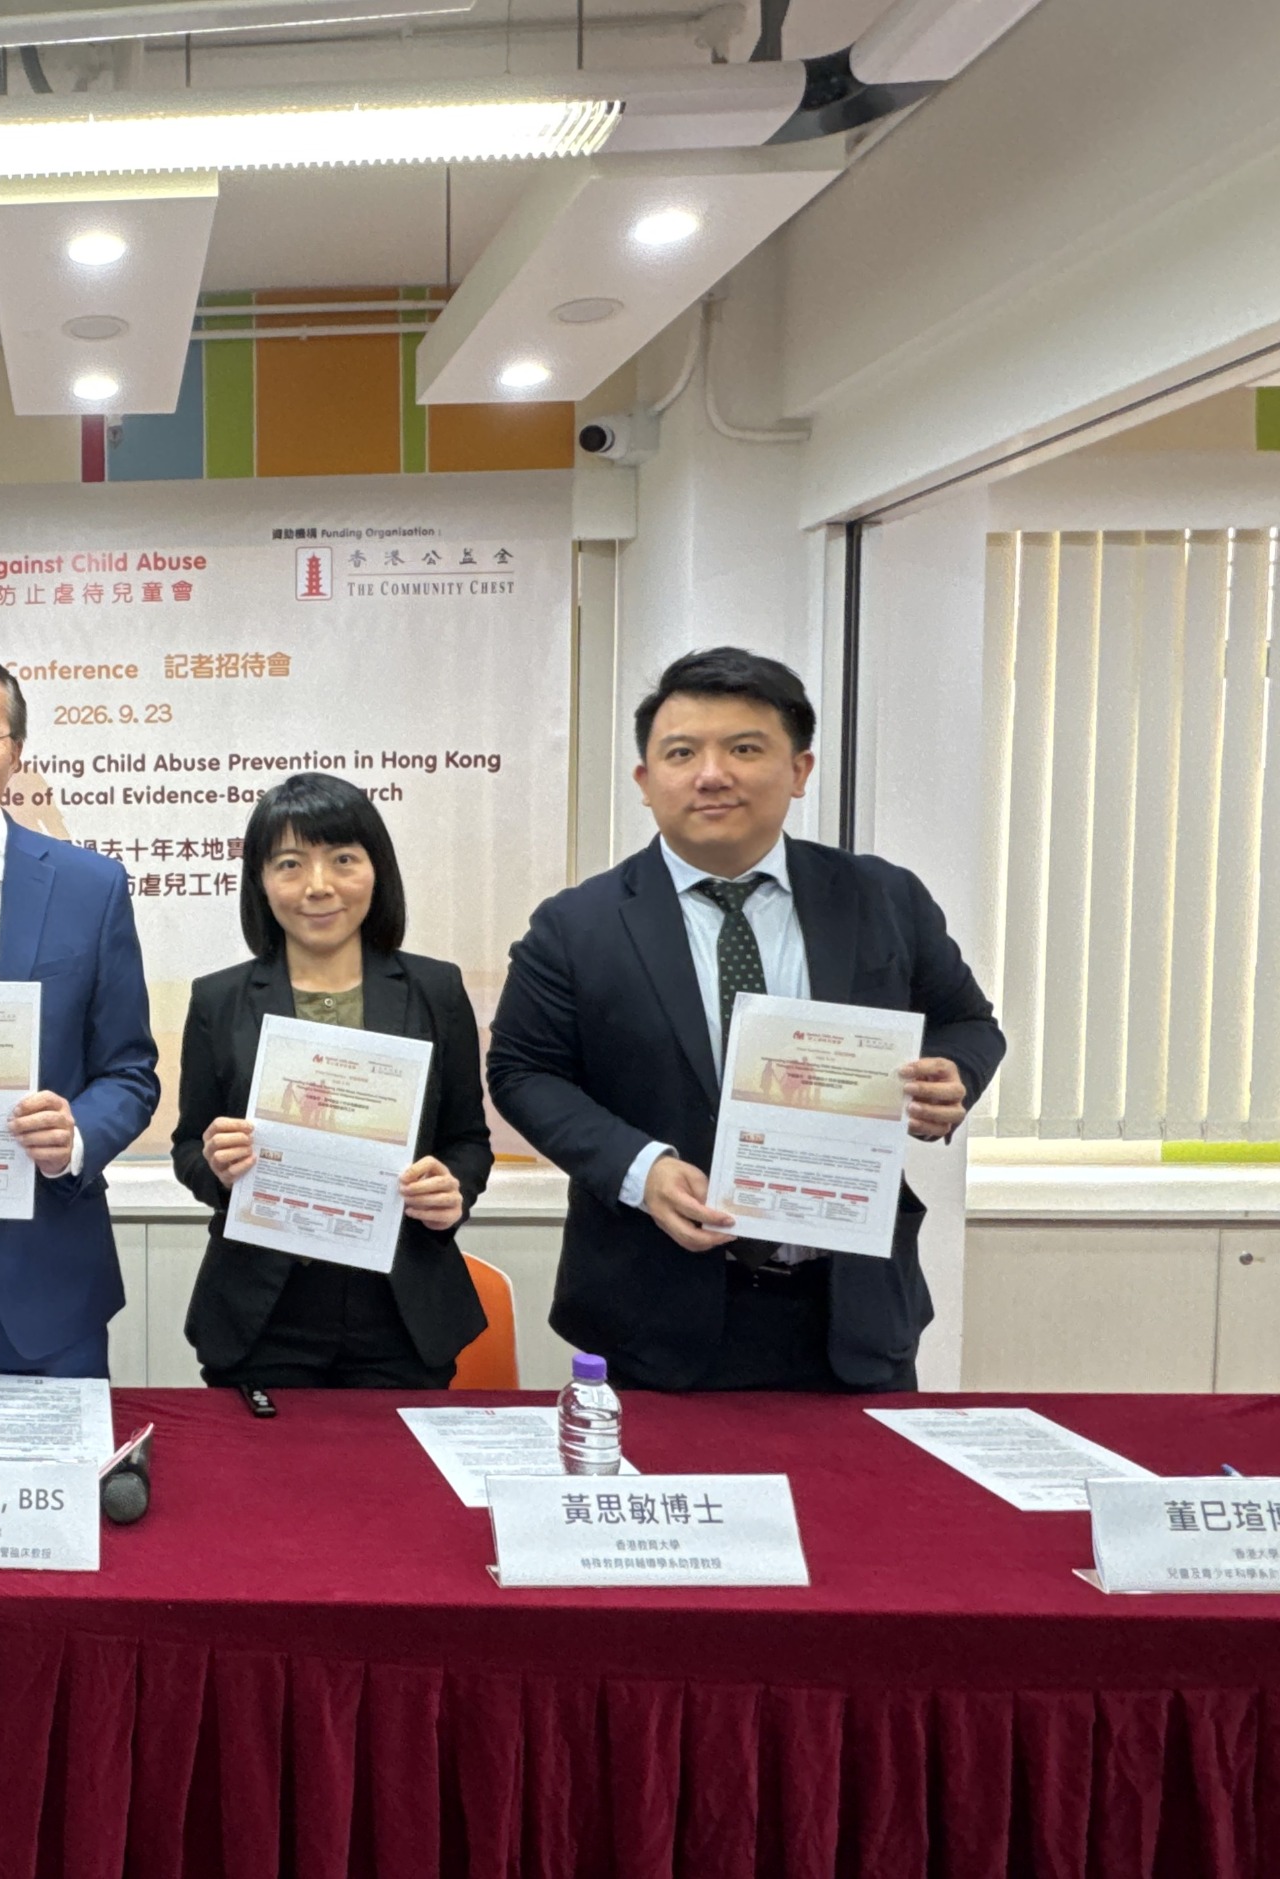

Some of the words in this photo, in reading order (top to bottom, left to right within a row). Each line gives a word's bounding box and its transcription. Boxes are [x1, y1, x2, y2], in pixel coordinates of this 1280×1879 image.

[321, 529, 362, 540] Funding
[366, 527, 435, 538] Organisation
[71, 552, 128, 573] Child
[136, 551, 207, 571] Abuse
[347, 547, 515, 568] 香港公益金
[164, 651, 292, 679] 記者招待會
[92, 754, 146, 773] Child
[153, 753, 221, 772] Abuse
[228, 751, 347, 771] Prevention
[354, 750, 375, 769] in
[381, 751, 438, 773] Hong
[445, 750, 502, 773] Kong
[31, 787, 54, 806] of
[61, 786, 115, 806] Local
[122, 785, 266, 805] Evidence-Bas
[18, 1488, 65, 1511] BBS
[561, 1492, 725, 1526] 黃思敏博士
